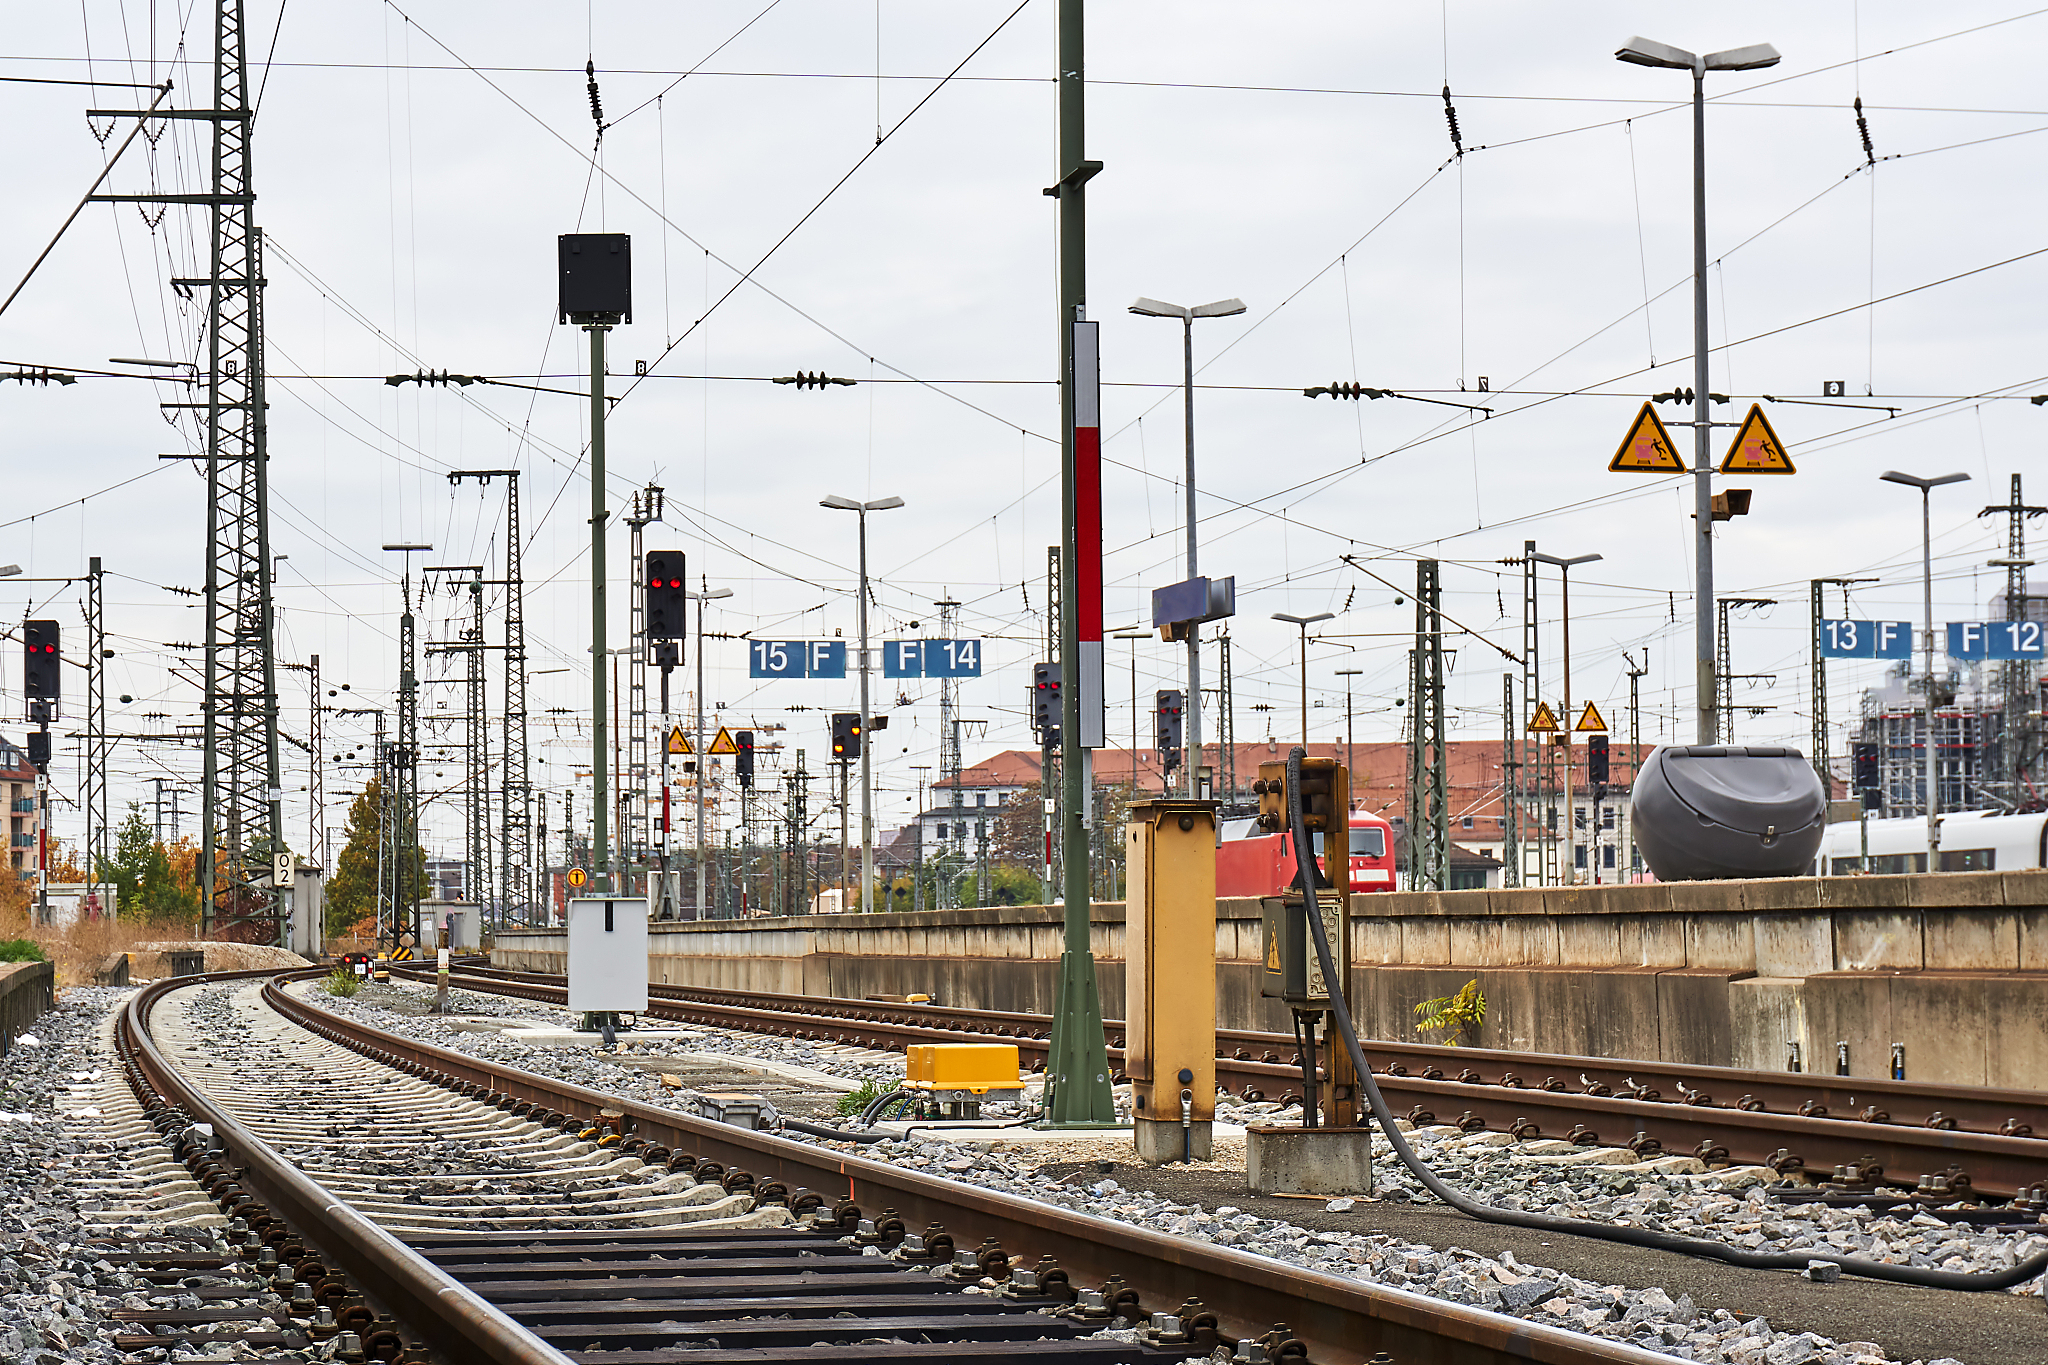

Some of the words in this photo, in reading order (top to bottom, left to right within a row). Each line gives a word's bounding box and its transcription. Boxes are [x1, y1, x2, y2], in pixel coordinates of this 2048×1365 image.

[227, 362, 235, 375] 8
[637, 362, 645, 374] 8
[1826, 620, 1858, 650] 13
[1881, 621, 1898, 651] F
[1963, 622, 1981, 652] F
[2006, 621, 2040, 652] 12
[754, 641, 788, 671] 15
[812, 641, 831, 671] F
[899, 641, 918, 671] F
[943, 640, 977, 670] 14
[664, 723, 671, 731] 15
[280, 869, 289, 883] 2
